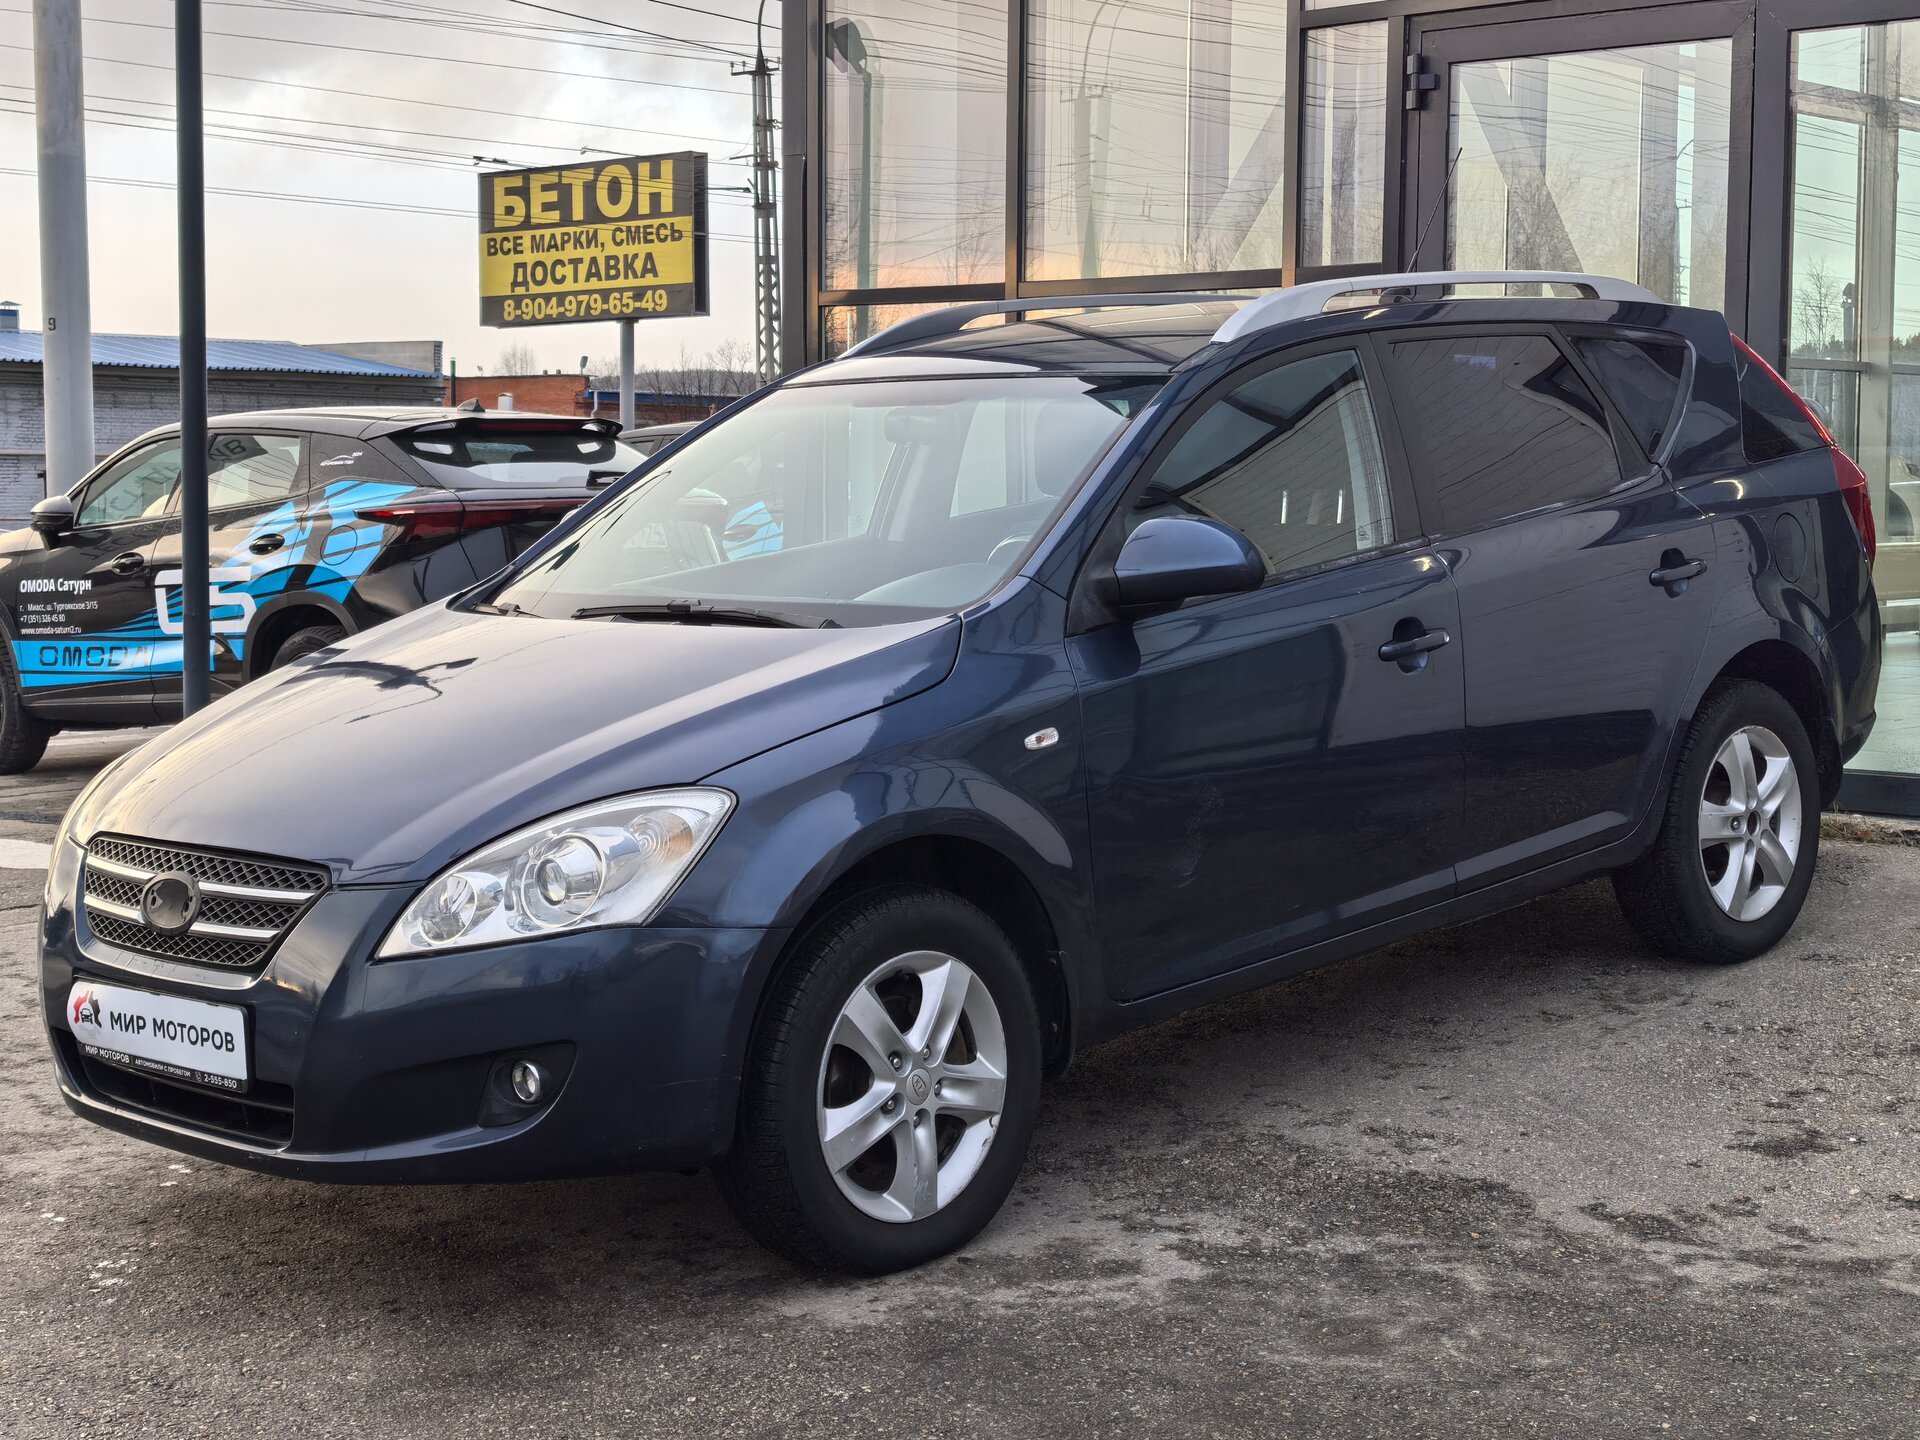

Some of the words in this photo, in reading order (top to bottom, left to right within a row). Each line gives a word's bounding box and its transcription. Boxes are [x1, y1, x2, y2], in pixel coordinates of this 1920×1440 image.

[493, 159, 674, 228] БЕТОН
[486, 236, 523, 257] ВСЕ
[531, 228, 605, 253] МАРКИ,
[612, 222, 683, 247] СМЕСЬ
[511, 252, 659, 293] ДОСТАВКА
[503, 289, 668, 321] 8-904-979-65-49
[48, 317, 56, 331] 9
[20, 579, 56, 593] OMODA
[57, 578, 92, 595] Сатурн
[27, 603, 46, 612] Миасс,
[86, 601, 98, 610] 3/15
[20, 615, 27, 623] +7
[28, 614, 41, 624] (351)
[51, 614, 58, 622] 45
[21, 625, 82, 635] www.omoda-saturn2.ru
[40, 646, 149, 667] OMODA
[110, 1011, 146, 1035] МИР
[153, 1018, 235, 1052] МОТОРОВ
[85, 1045, 99, 1055] МИР
[99, 1048, 130, 1063] МОТОРОВ
[135, 1059, 164, 1071] АВТОМОБИЛИ
[168, 1066, 191, 1078] ПРОБЕГОМ
[204, 1074, 237, 1089] 2-555-850
